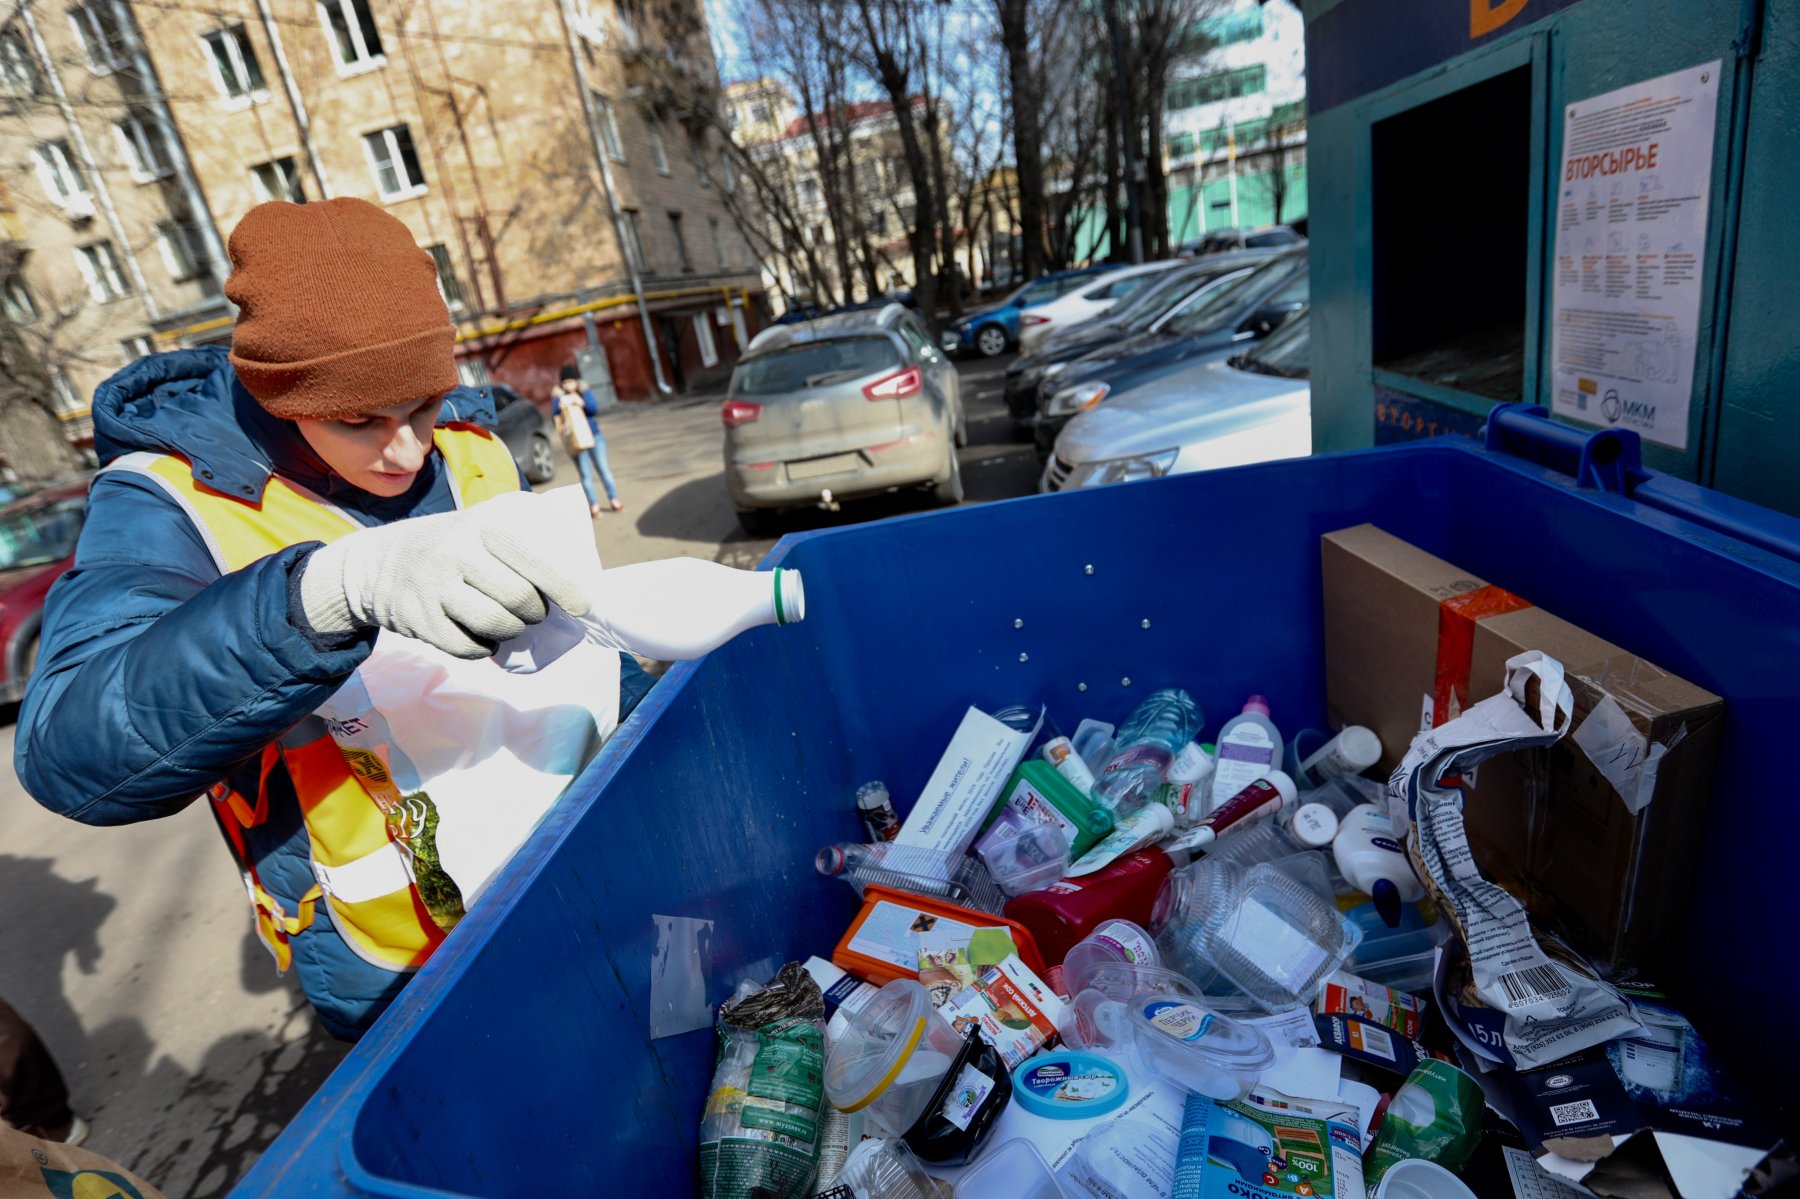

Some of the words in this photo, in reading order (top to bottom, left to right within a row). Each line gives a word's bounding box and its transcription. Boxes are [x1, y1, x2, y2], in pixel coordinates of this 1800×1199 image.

[1565, 143, 1659, 182] ВТОРСЫРЬЕ
[918, 789, 951, 835] Уважаемые
[946, 756, 971, 789] жители!
[1001, 981, 1015, 995] СОК
[1011, 992, 1037, 1018] ДЕТСКИЙ
[1158, 1007, 1195, 1027] ПЕРЧИК
[1291, 1158, 1318, 1172] 100%
